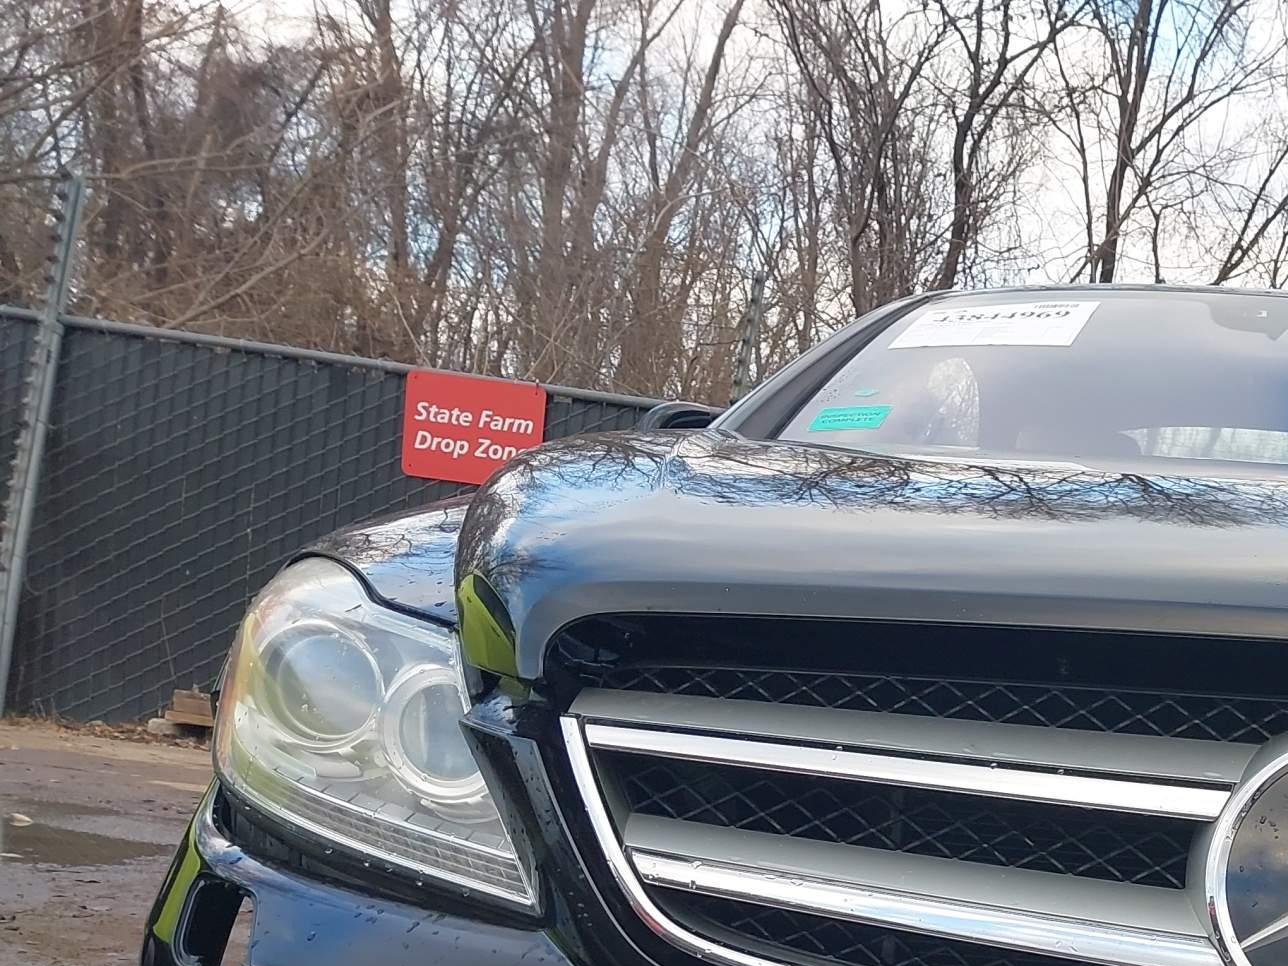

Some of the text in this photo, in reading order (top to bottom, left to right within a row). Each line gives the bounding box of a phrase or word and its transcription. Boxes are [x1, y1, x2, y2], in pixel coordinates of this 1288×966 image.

[414, 401, 534, 435] State Farm
[414, 430, 470, 459] Drop
